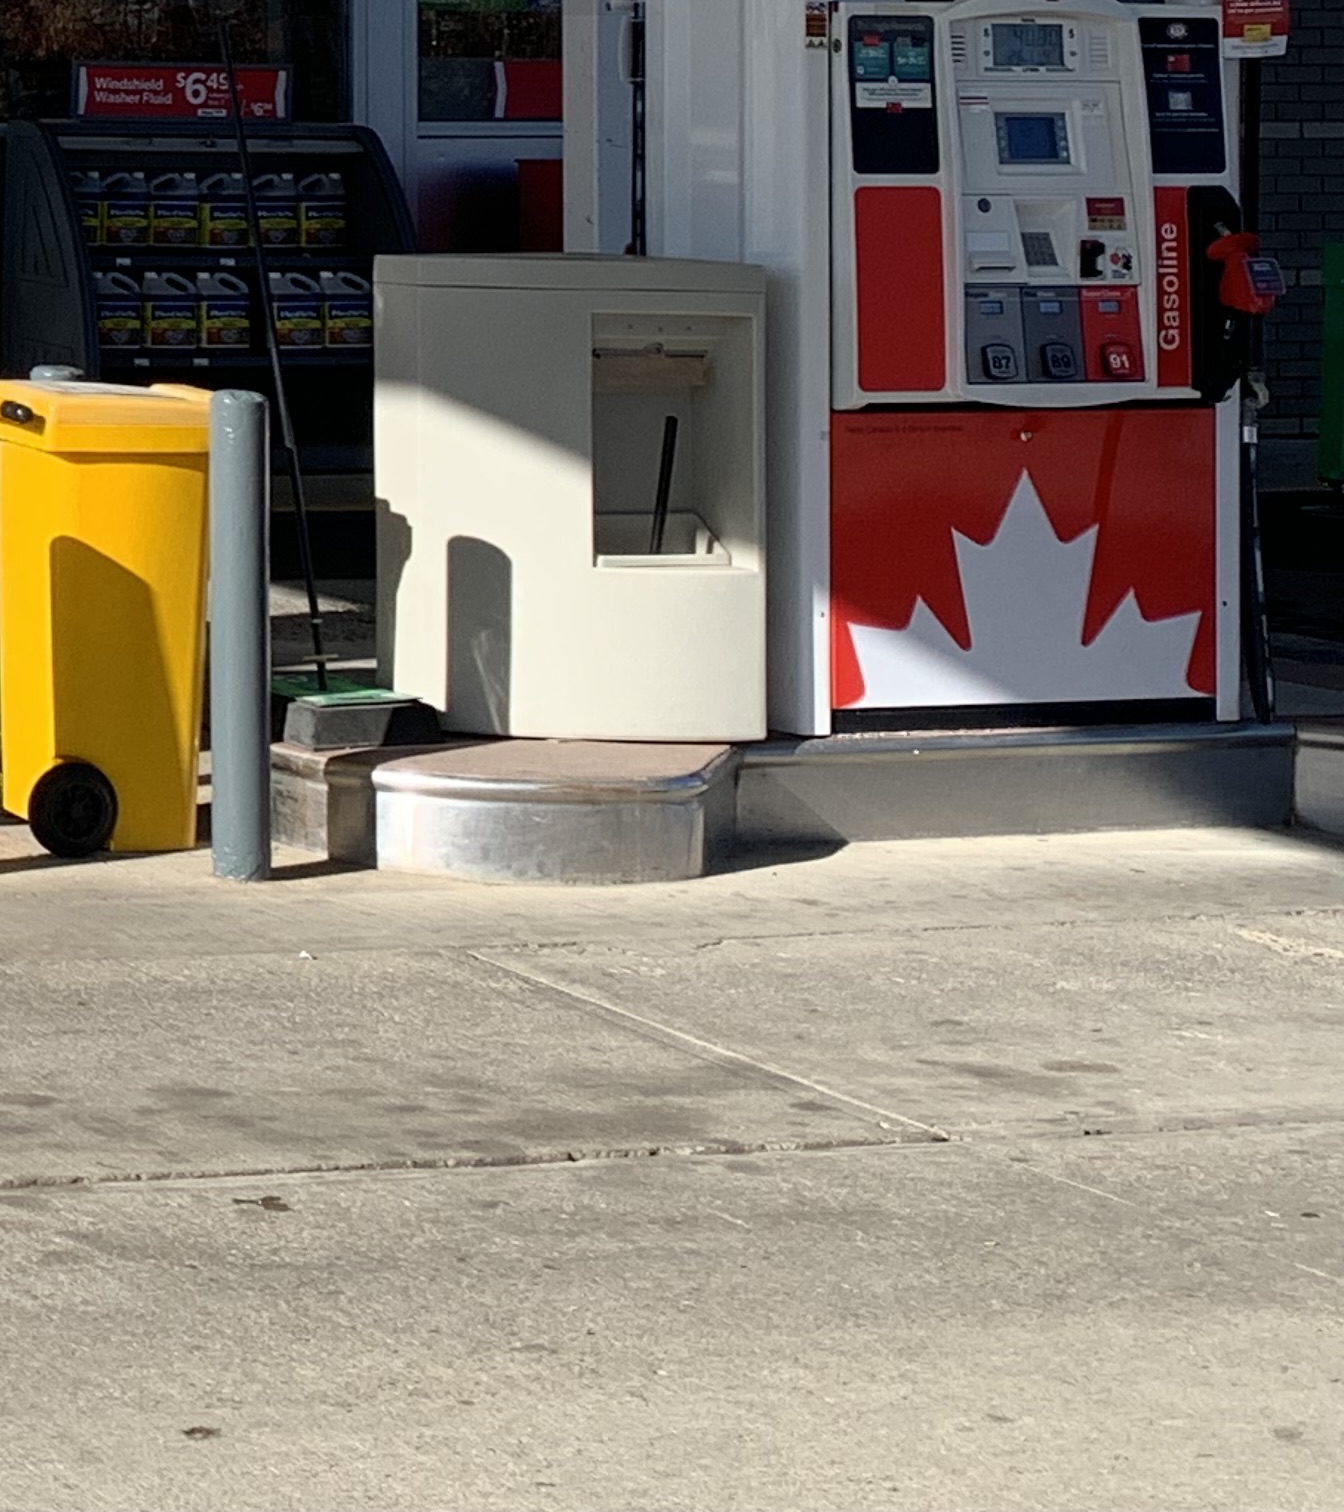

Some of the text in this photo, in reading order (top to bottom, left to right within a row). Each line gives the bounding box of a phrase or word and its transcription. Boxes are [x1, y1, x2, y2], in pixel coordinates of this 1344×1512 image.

[95, 76, 164, 91] Windshield
[94, 91, 173, 105] Washer Fluid
[1157, 222, 1180, 351] Gasoline
[992, 355, 1011, 370] 87
[1050, 355, 1071, 369] 89
[1109, 354, 1130, 369] 91
